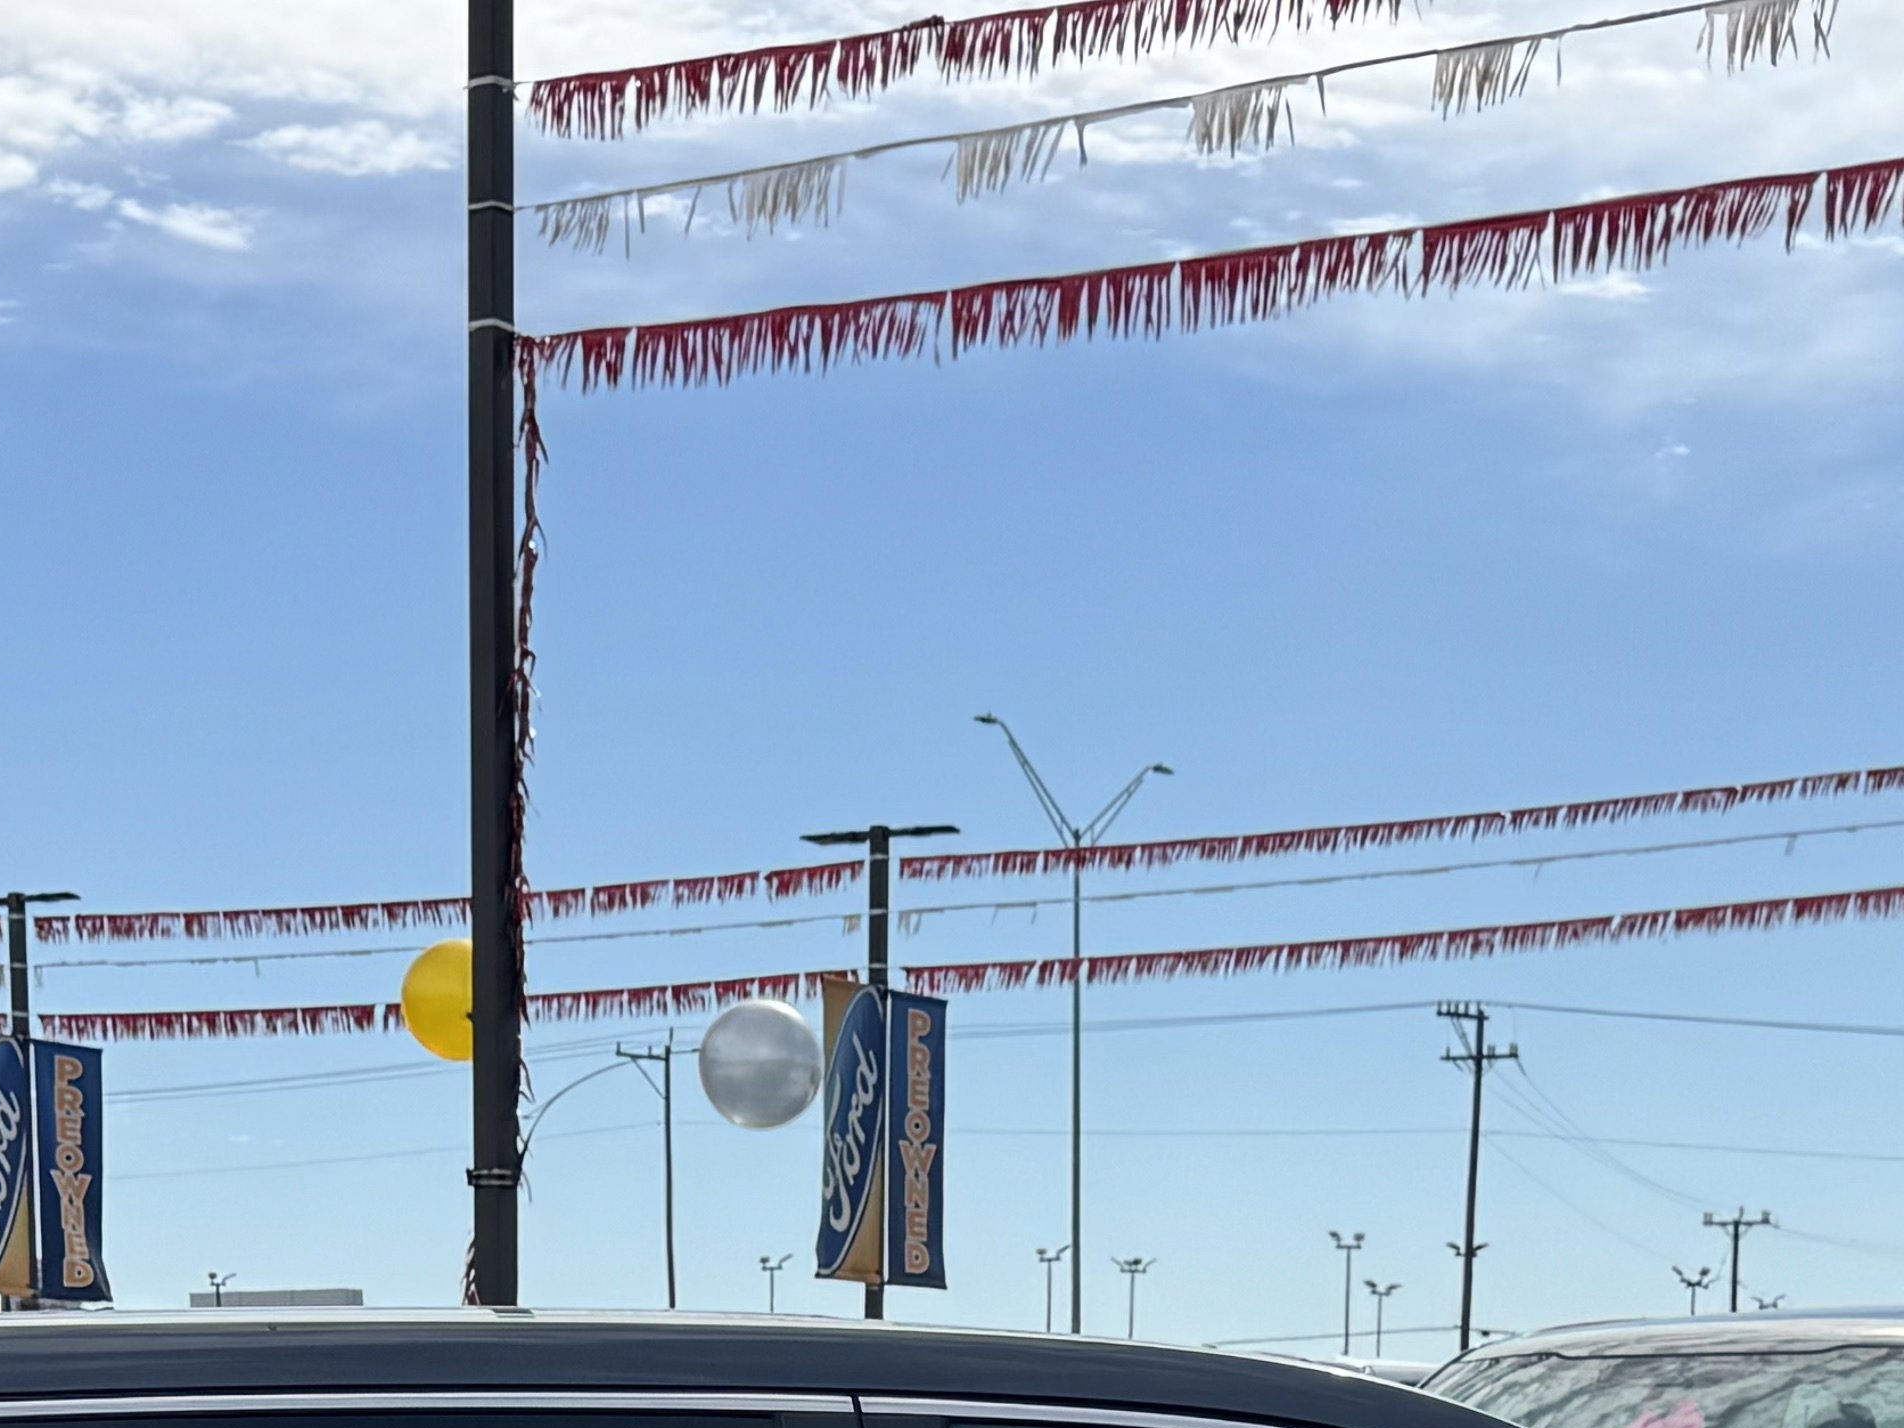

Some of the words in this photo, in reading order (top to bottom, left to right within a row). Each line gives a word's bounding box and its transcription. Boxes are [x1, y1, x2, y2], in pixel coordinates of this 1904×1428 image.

[50, 1056, 94, 1287] PREOWNED
[822, 1031, 878, 1233] Ford
[899, 1008, 936, 1274] PREOWNED
